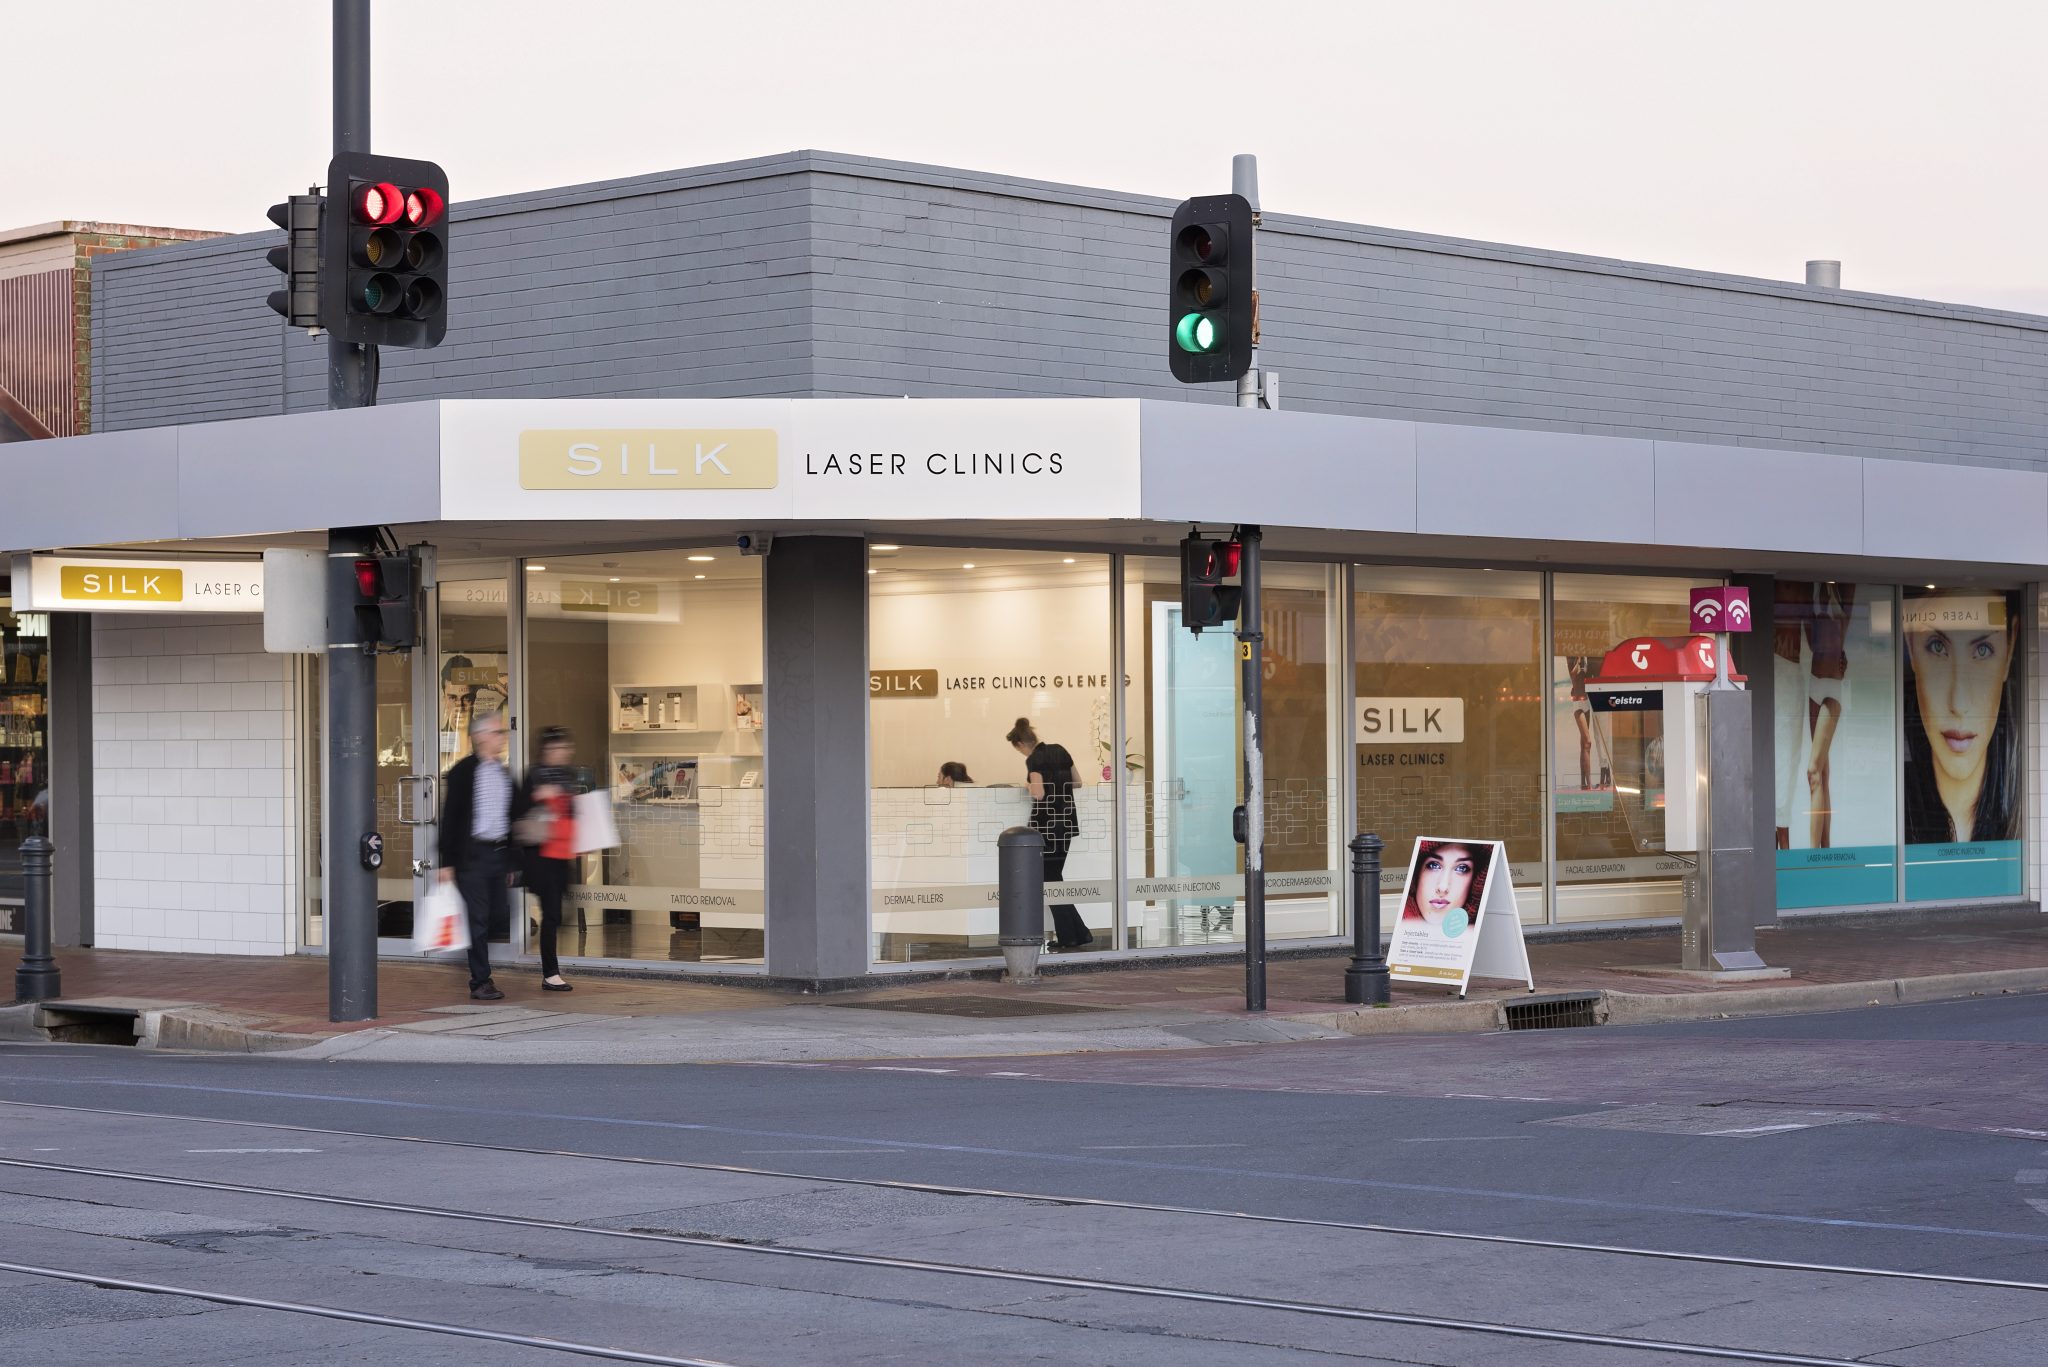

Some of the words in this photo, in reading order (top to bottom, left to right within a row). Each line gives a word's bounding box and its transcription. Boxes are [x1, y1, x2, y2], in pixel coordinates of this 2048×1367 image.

[567, 442, 732, 476] SILK
[806, 454, 906, 476] LASER
[927, 452, 1065, 475] CLINICS
[83, 573, 161, 595] SILK
[195, 583, 242, 596] LASER
[1242, 644, 1249, 657] 3
[458, 671, 489, 681] SILK
[870, 675, 923, 692] SILK
[946, 677, 985, 690] LASER
[992, 676, 1046, 689] CLINICS
[1054, 674, 1131, 688] GLENEG
[1608, 696, 1643, 708] Telstra
[1363, 707, 1443, 733] SILK
[1361, 754, 1395, 766] LASER
[1400, 753, 1445, 766] CLINICS
[1821, 853, 1833, 862] HAIR
[1566, 864, 1585, 874] FACIAL
[1380, 873, 1395, 883] ASER
[1065, 887, 1101, 897] REMOVAL
[1135, 884, 1151, 894] ANTI
[1152, 883, 1182, 893] WRINKLE
[1182, 882, 1220, 892] INJECTIONS
[575, 892, 592, 902] HAIR
[593, 892, 628, 903] REMOVAL
[671, 894, 699, 905] TATTOO
[700, 895, 737, 906] REMOVAL
[884, 895, 916, 905] DERMAL
[917, 893, 944, 904] FILLERS
